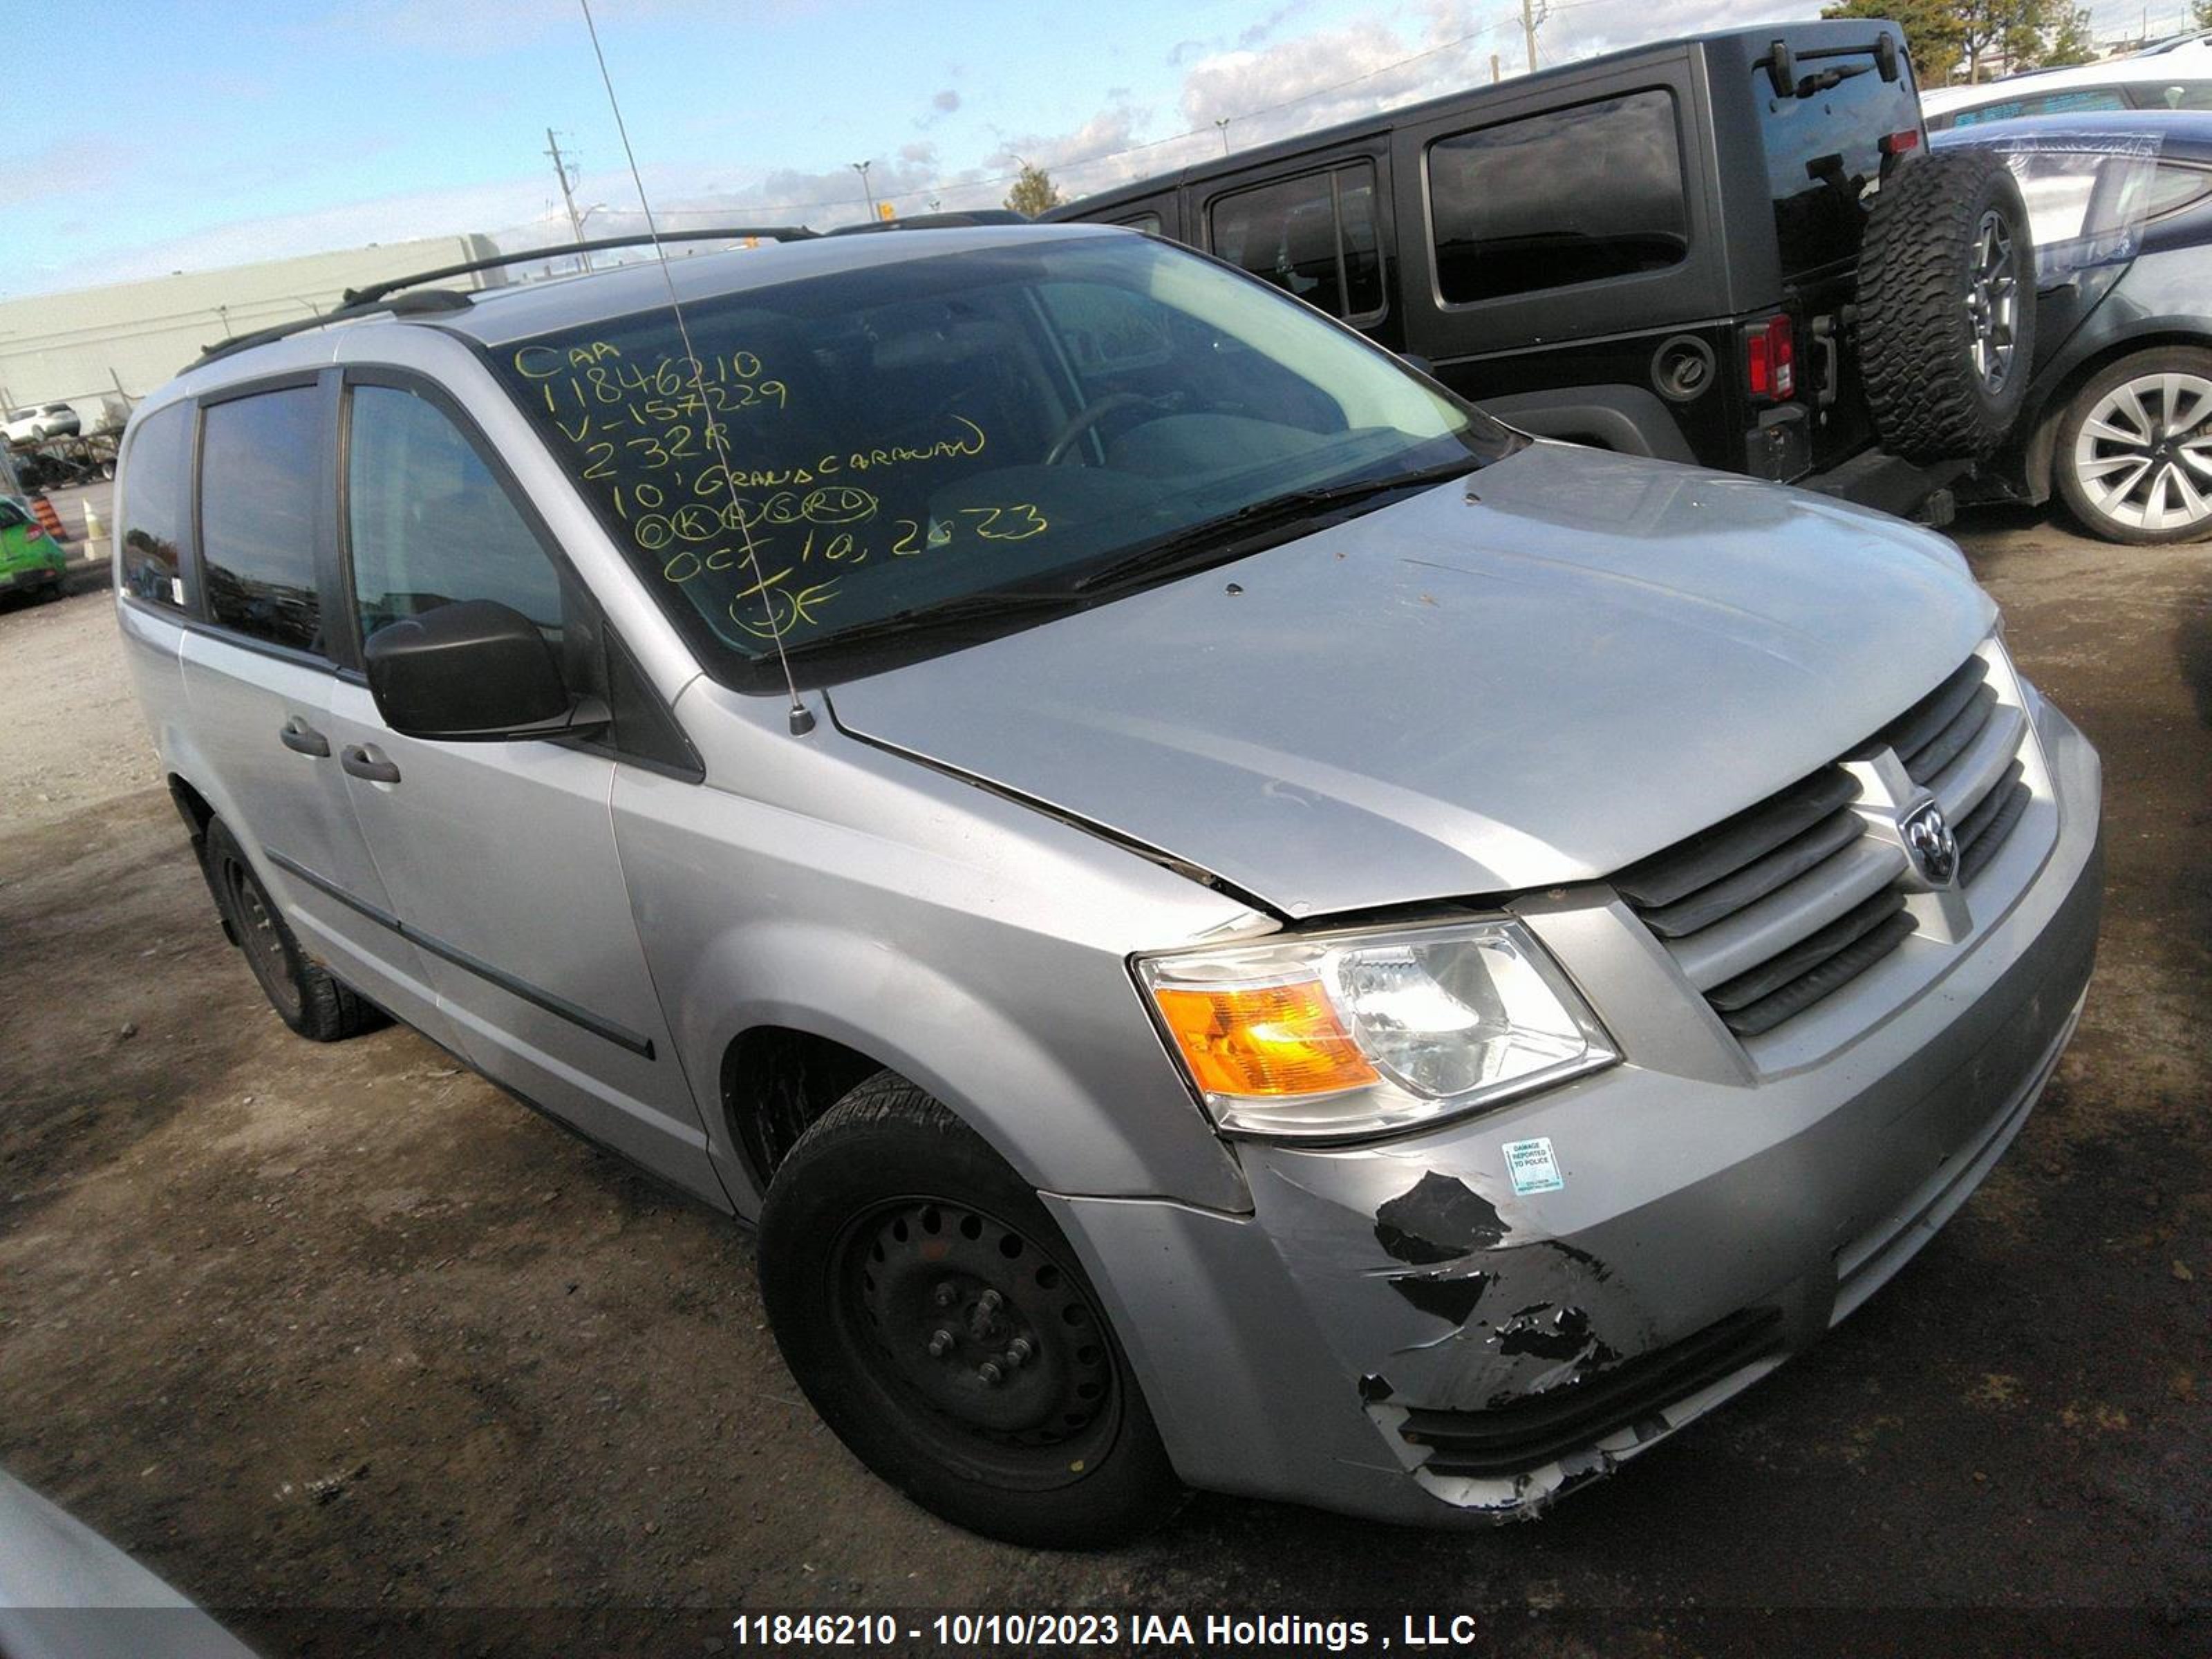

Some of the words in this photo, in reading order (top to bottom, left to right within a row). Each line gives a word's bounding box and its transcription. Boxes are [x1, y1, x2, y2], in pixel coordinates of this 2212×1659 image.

[514, 341, 620, 378] CAA
[543, 351, 762, 413] 11846210
[1525, 1156, 1549, 1166] POLICE
